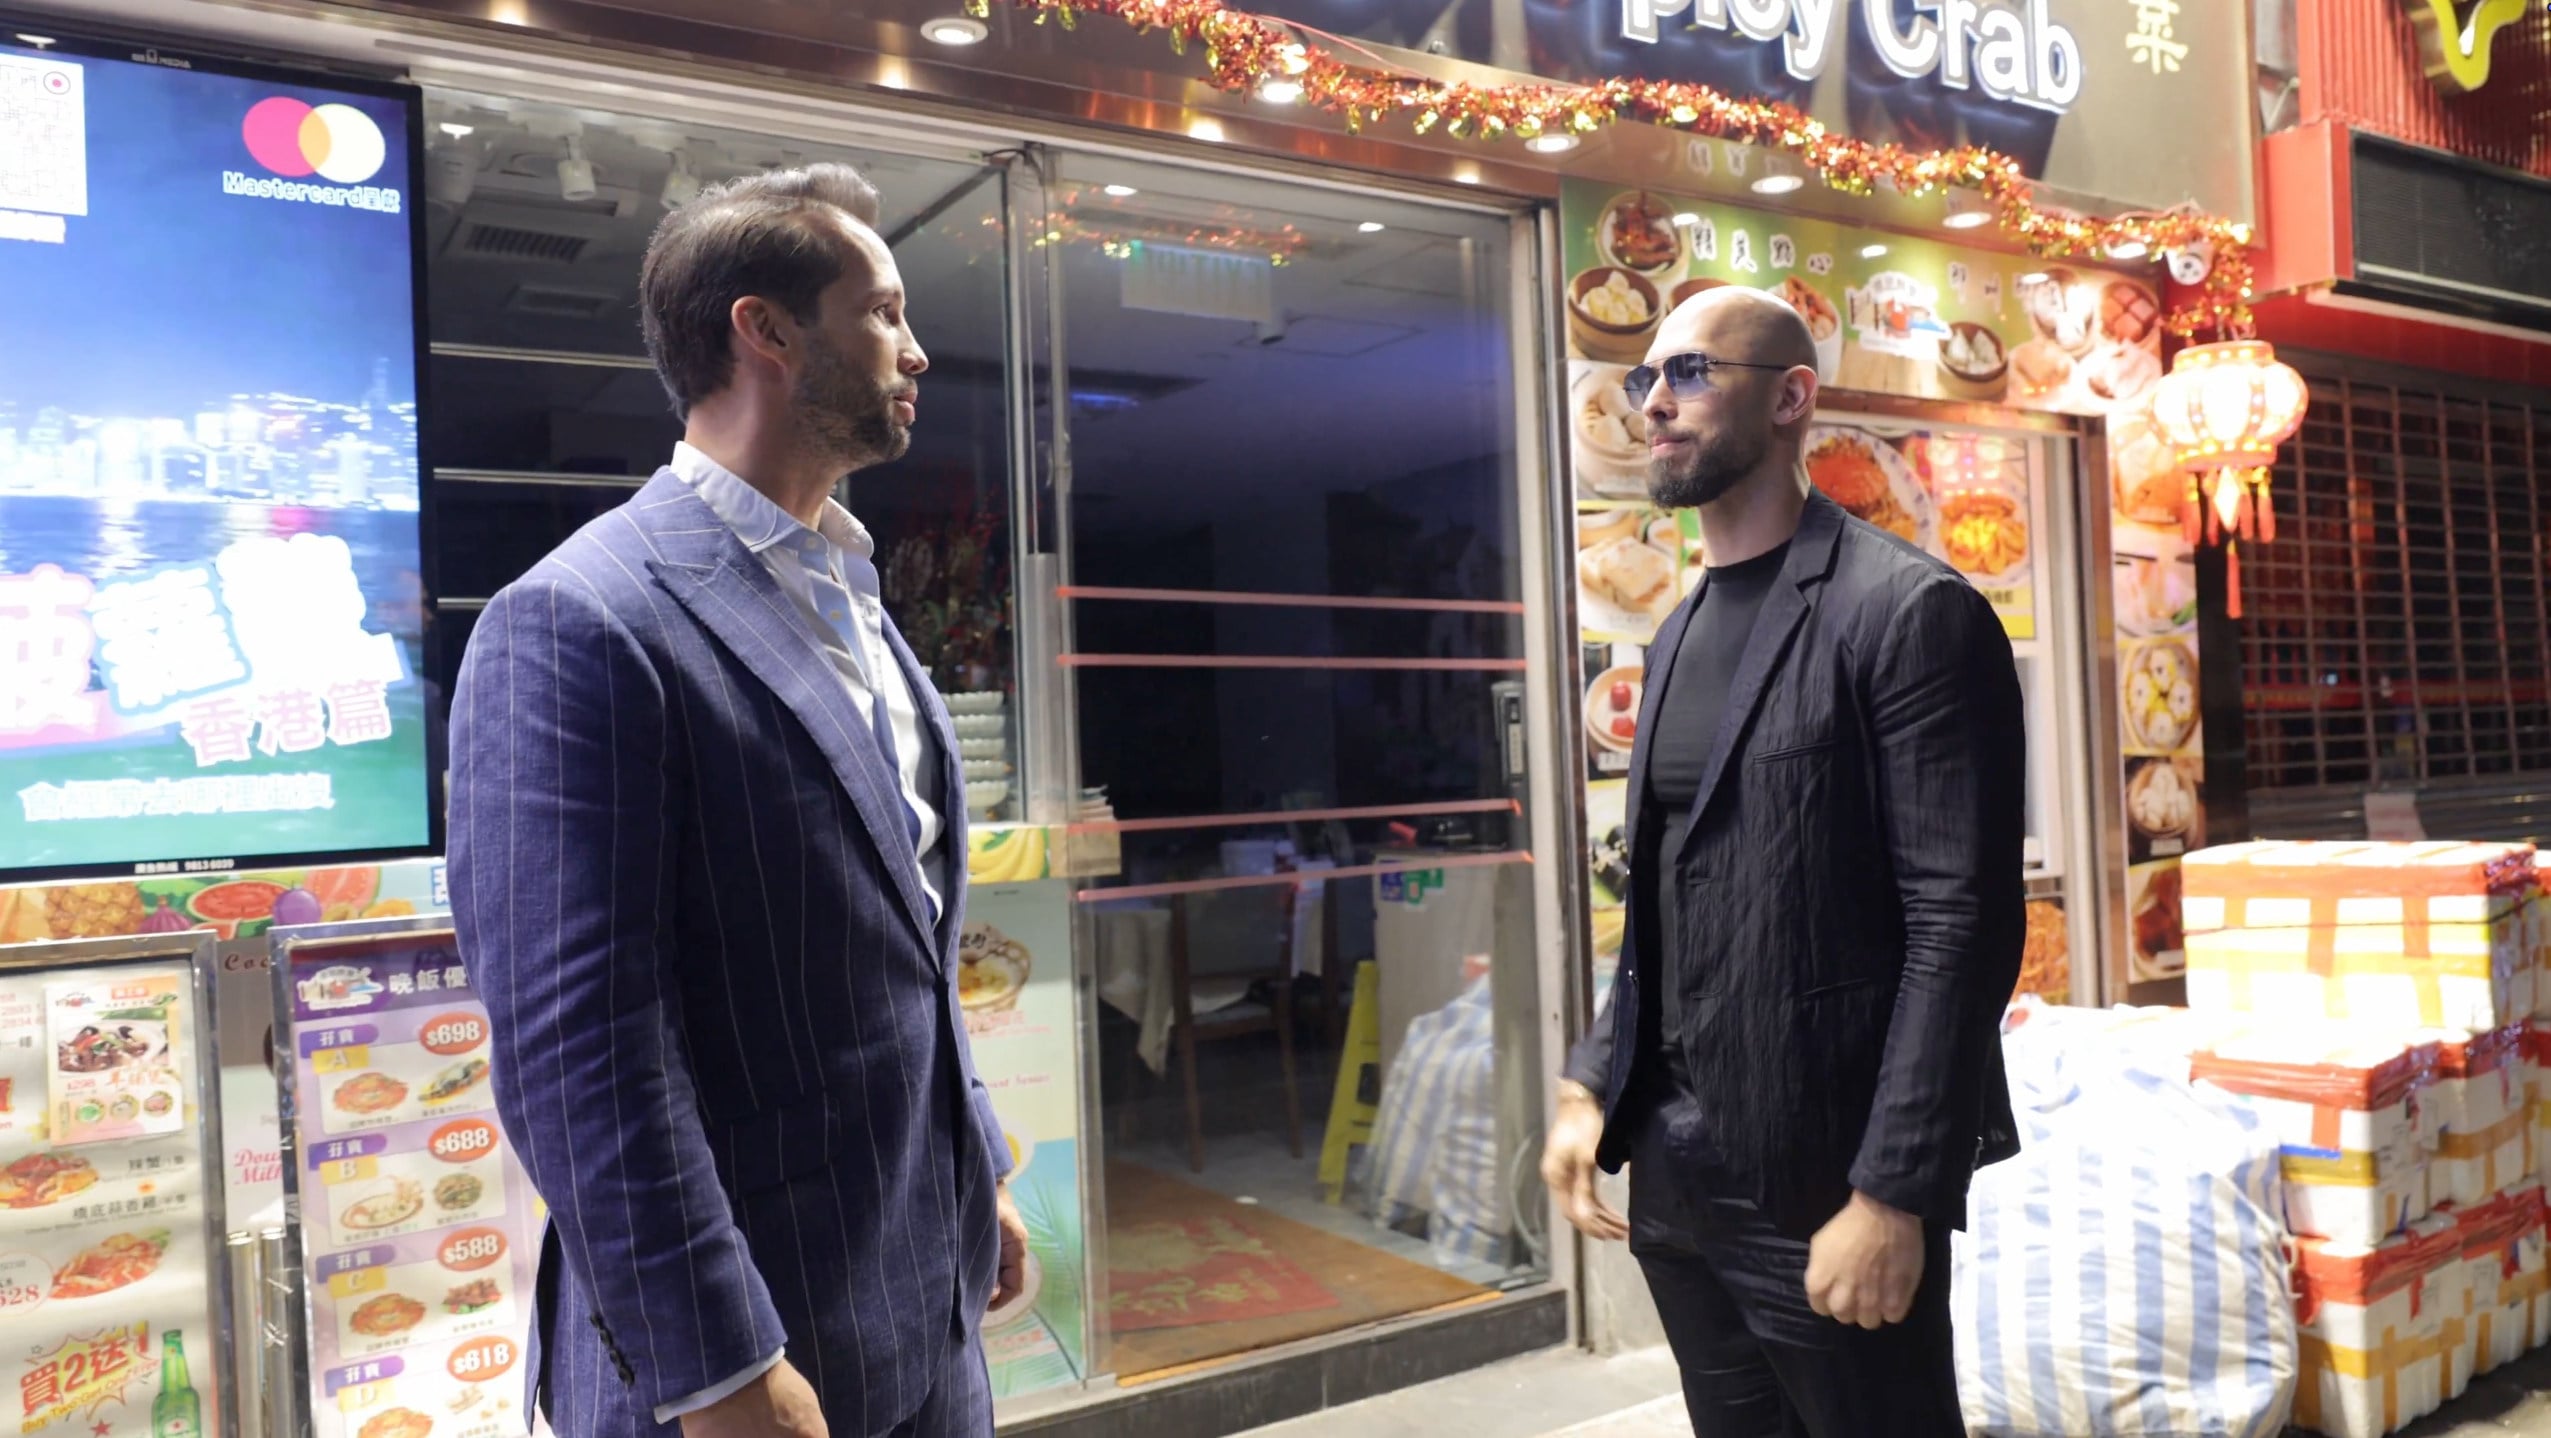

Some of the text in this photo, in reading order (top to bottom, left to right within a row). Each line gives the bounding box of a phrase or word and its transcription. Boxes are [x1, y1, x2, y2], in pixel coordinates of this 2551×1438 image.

[1868, 0, 2085, 114] Crab
[184, 680, 391, 765] 香港篇
[425, 1020, 481, 1048] $698
[331, 1050, 350, 1068] A
[433, 1126, 491, 1156] $688
[338, 1161, 359, 1180] B
[442, 1234, 499, 1264] $588
[20, 1320, 149, 1417] 買2送1
[453, 1344, 510, 1375] $618
[358, 1384, 377, 1406] D
